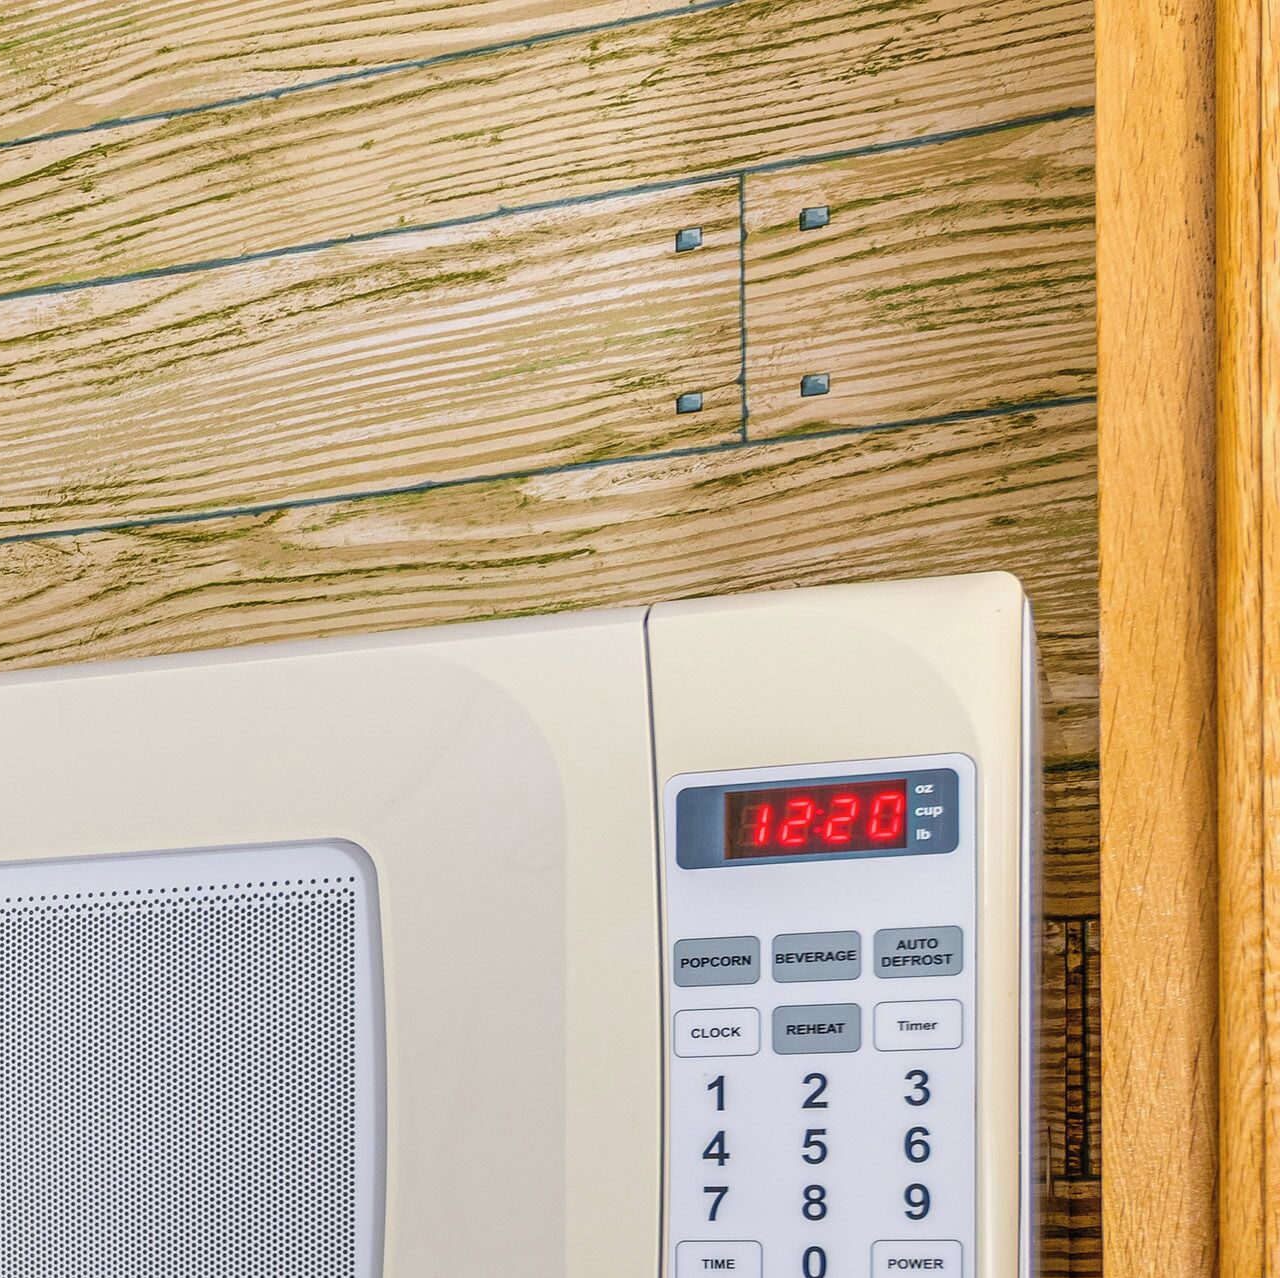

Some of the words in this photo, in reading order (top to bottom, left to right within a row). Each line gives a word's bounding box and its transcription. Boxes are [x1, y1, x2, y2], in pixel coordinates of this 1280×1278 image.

[914, 783, 934, 795] oz
[914, 804, 944, 818] cup
[754, 792, 904, 846] 12:20
[915, 828, 931, 840] lb
[896, 937, 939, 951] AUTO
[680, 955, 752, 969] POPCORN
[775, 949, 857, 964] BEVERAGE
[881, 953, 953, 968] DEFROST
[690, 1026, 742, 1040] CLOCK
[786, 1022, 846, 1036] REHEAT
[897, 1019, 938, 1032] Timer
[707, 1075, 725, 1111] 1
[801, 1073, 828, 1109] 2
[903, 1069, 931, 1106] 3
[702, 1130, 730, 1166] 4
[801, 1128, 828, 1164] 5
[903, 1126, 931, 1163] 6
[703, 1185, 729, 1221] 7
[801, 1184, 828, 1221] 8
[903, 1183, 931, 1220] 9
[702, 1258, 735, 1270] TIME
[887, 1258, 944, 1270] POWER
